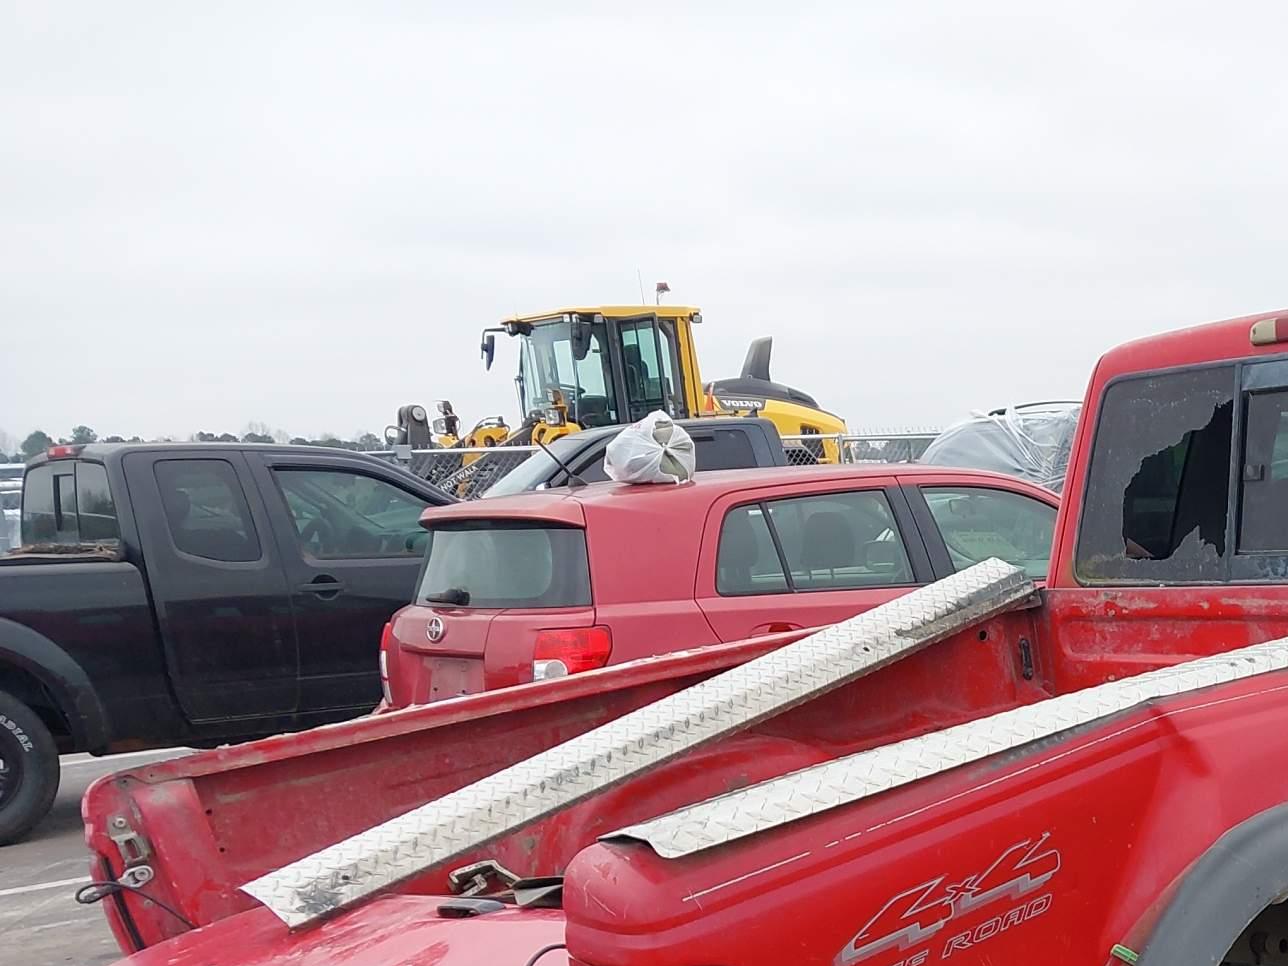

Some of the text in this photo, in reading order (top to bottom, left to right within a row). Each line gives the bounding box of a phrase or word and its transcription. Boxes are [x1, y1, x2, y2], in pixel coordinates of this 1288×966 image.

[721, 400, 763, 408] VOLVO
[440, 477, 457, 491] NOT
[941, 893, 1053, 959] ROAD
